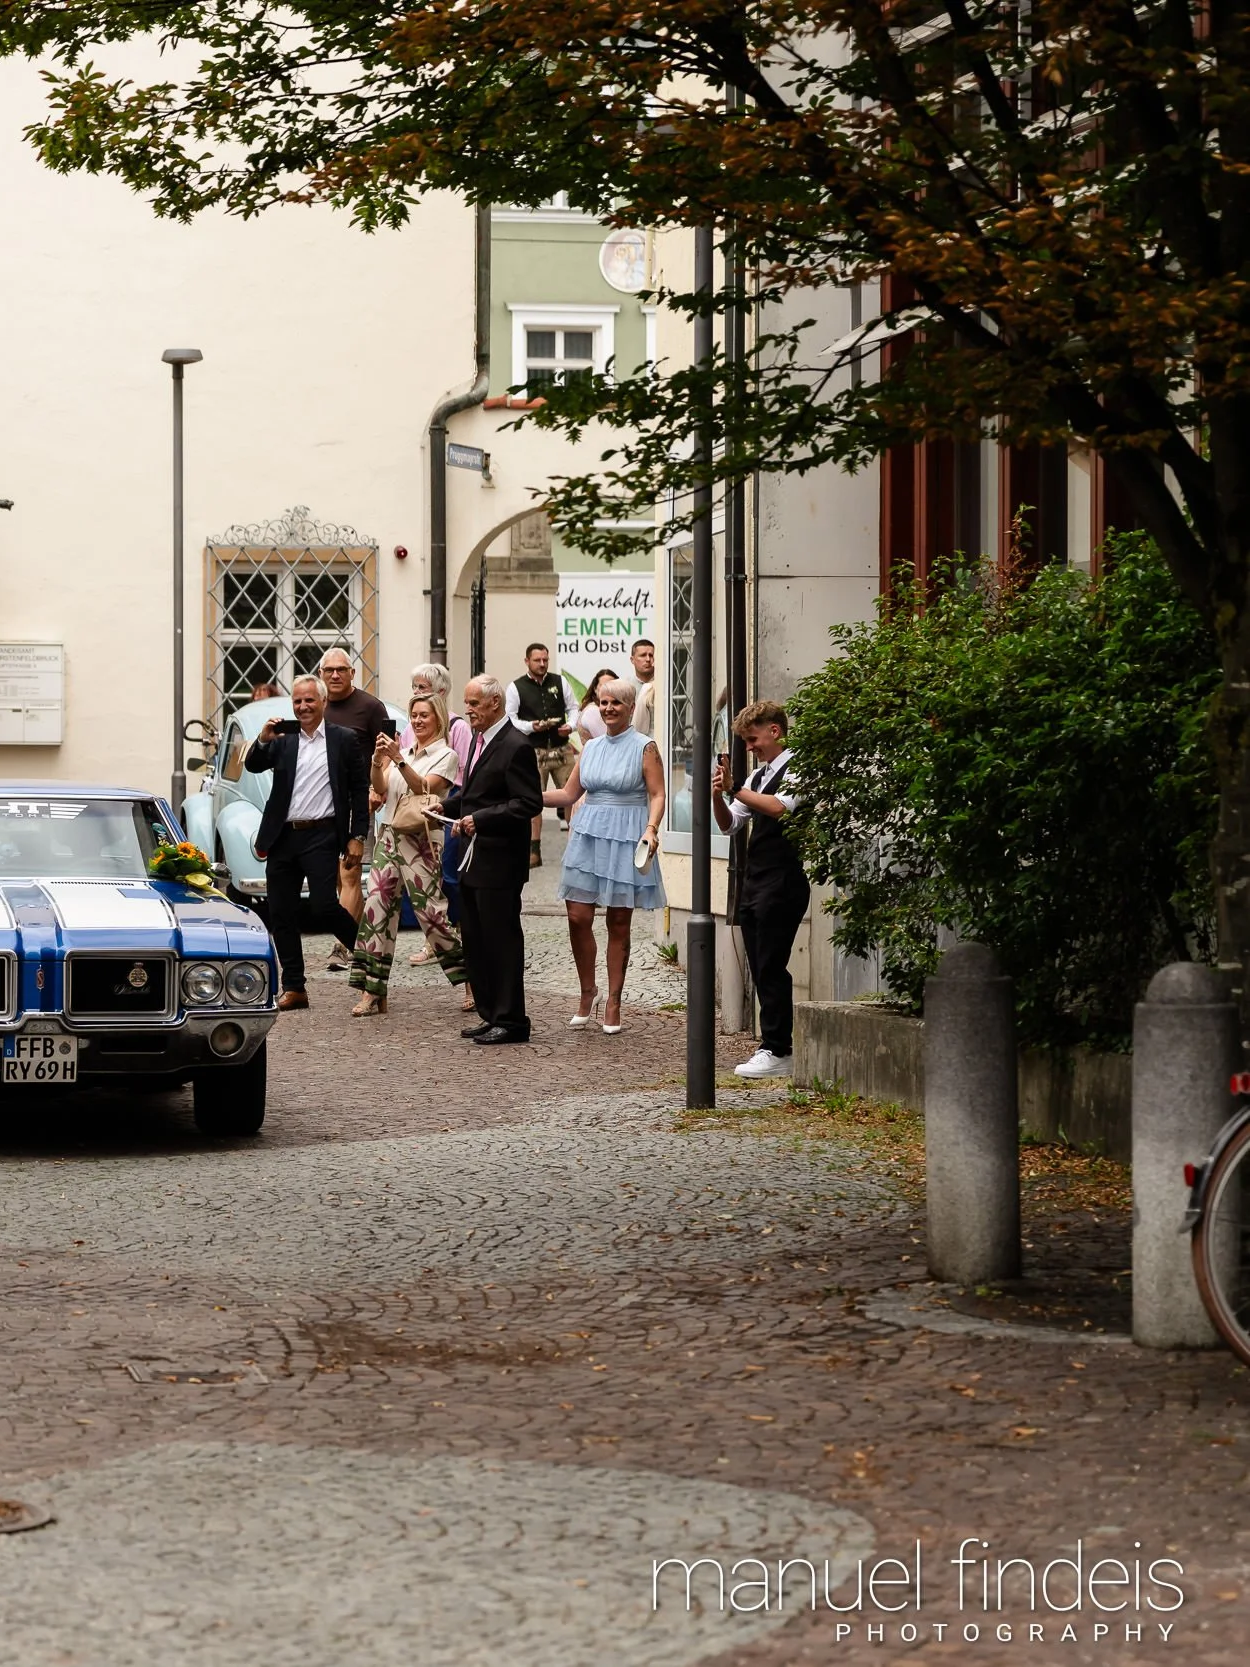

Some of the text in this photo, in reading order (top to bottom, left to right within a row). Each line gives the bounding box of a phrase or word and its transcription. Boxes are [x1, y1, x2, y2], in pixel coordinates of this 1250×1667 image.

[585, 639, 626, 653] Obst
[16, 1037, 55, 1058] FFB
[6, 1061, 30, 1080] RY
